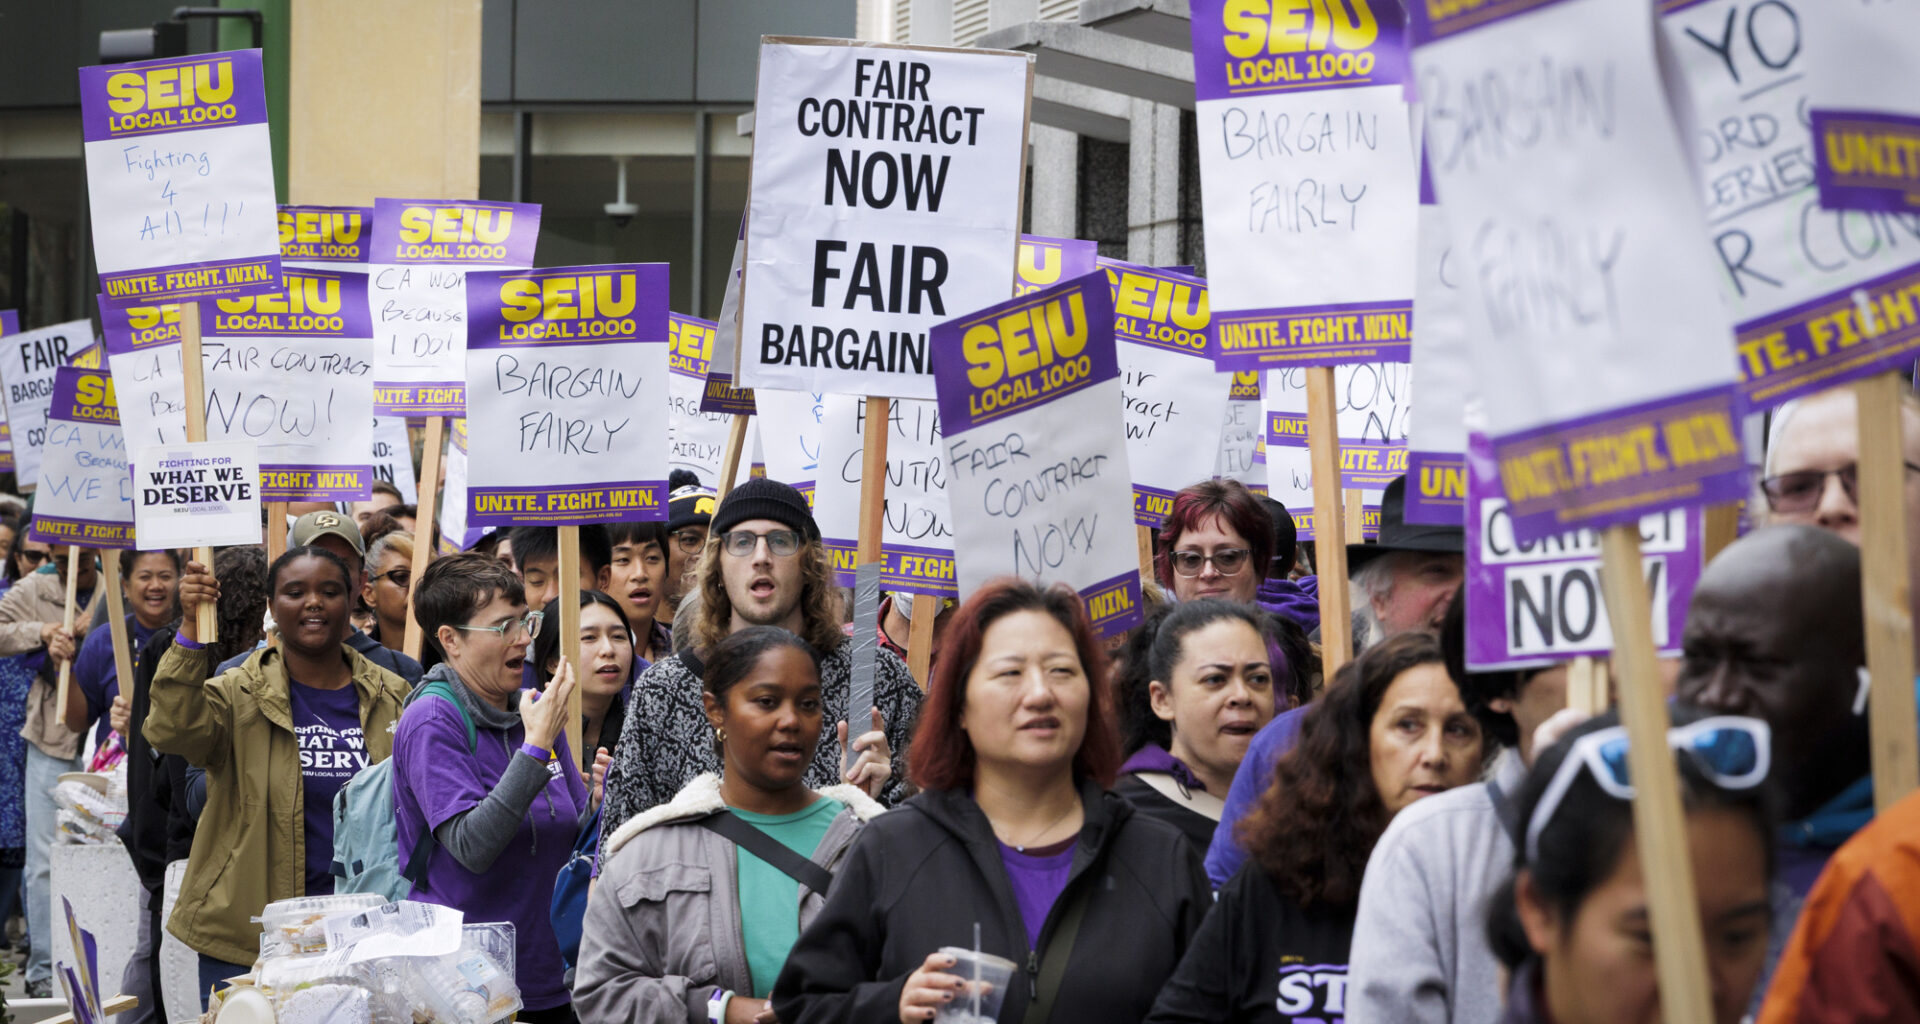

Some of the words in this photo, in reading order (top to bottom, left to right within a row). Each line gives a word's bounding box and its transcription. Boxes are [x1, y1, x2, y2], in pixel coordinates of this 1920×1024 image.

[1223, 0, 1378, 59] SEIU
[1684, 0, 1802, 84] YO
[854, 58, 931, 102] FAIR
[1226, 57, 1304, 86] LOCAL
[1306, 51, 1376, 79] 1000
[106, 61, 234, 114] SEIU
[109, 110, 178, 132] LOCAL
[179, 103, 237, 123] 1000
[797, 97, 985, 146] CONTRACT
[1222, 107, 1378, 160] BARGAIN
[123, 145, 210, 180] Fighting
[1825, 130, 1920, 179] UNIT
[161, 180, 177, 205] 4
[824, 148, 951, 213] NOW
[1249, 178, 1367, 233] FAIRLY
[277, 212, 362, 244] SEIU
[399, 207, 514, 244] SEIU
[1799, 199, 1920, 273] CON
[280, 244, 320, 257] OCAL
[321, 244, 360, 257] 1000
[395, 244, 454, 258] LOCAL
[456, 245, 507, 259] 1000
[106, 275, 164, 297] UNITE.
[166, 269, 224, 290] FIGHT.
[226, 264, 274, 284] WIN.
[376, 268, 411, 289] CA
[811, 240, 949, 316] FAIR
[500, 274, 636, 322] SEIU
[131, 324, 181, 345] LOCA
[215, 315, 286, 331] LOCAL
[287, 315, 344, 331] 1000
[500, 322, 574, 340] LOCAL
[578, 319, 636, 338] 1000
[1114, 317, 1142, 336] AL
[1147, 323, 1207, 349] 1000
[1219, 322, 1286, 349] UNITE.
[1289, 316, 1362, 346] FIGHT.
[1364, 313, 1413, 342] WIN.
[20, 336, 70, 374] FAIR
[669, 320, 716, 361] EI
[760, 323, 934, 375] BARGAIN
[962, 292, 1089, 389] SEIU
[1737, 331, 1808, 383] TE.
[271, 346, 371, 376] CONTRACT
[496, 354, 642, 399] BARGAIN
[669, 356, 697, 373] CAL
[1120, 364, 1156, 387] ir
[11, 377, 54, 404] BARGA
[373, 389, 414, 404] NITE.
[418, 389, 464, 404] FIGHT.
[969, 376, 1039, 417] LOCAL
[1040, 354, 1091, 392] 1000
[205, 388, 334, 441] NOW!
[1273, 418, 1309, 435] UNI
[49, 423, 82, 446] CA
[520, 411, 630, 455] FAIRLY
[669, 428, 721, 464] AIRLY!
[75, 451, 128, 471] BECAUS
[159, 458, 210, 468] FIGHTING
[212, 457, 232, 465] FOR
[950, 433, 1031, 480] FAIR
[1340, 450, 1382, 471] ITE.
[45, 476, 102, 502] WE
[149, 469, 207, 485] WHAT
[214, 467, 243, 482] WE
[259, 472, 315, 489] FIGHT.
[316, 472, 363, 489] WIN.
[984, 454, 1108, 518] CONTRACT
[1419, 467, 1465, 498] UN
[143, 483, 251, 506] DESERVE
[475, 494, 543, 513] UNITE.
[547, 491, 606, 512] FIGHT.
[609, 489, 659, 508] WIN.
[1146, 494, 1174, 516] WI
[36, 520, 81, 536] UNITE.
[84, 525, 123, 539] FIGHT.
[1013, 514, 1097, 576] NOW
[900, 555, 955, 579] FIGH
[1089, 586, 1135, 621] WIN.
[1511, 560, 1662, 649] NO
[297, 736, 338, 749] HAT
[344, 736, 365, 750] W
[299, 750, 371, 769] SERV
[1276, 971, 1346, 1016] ST
